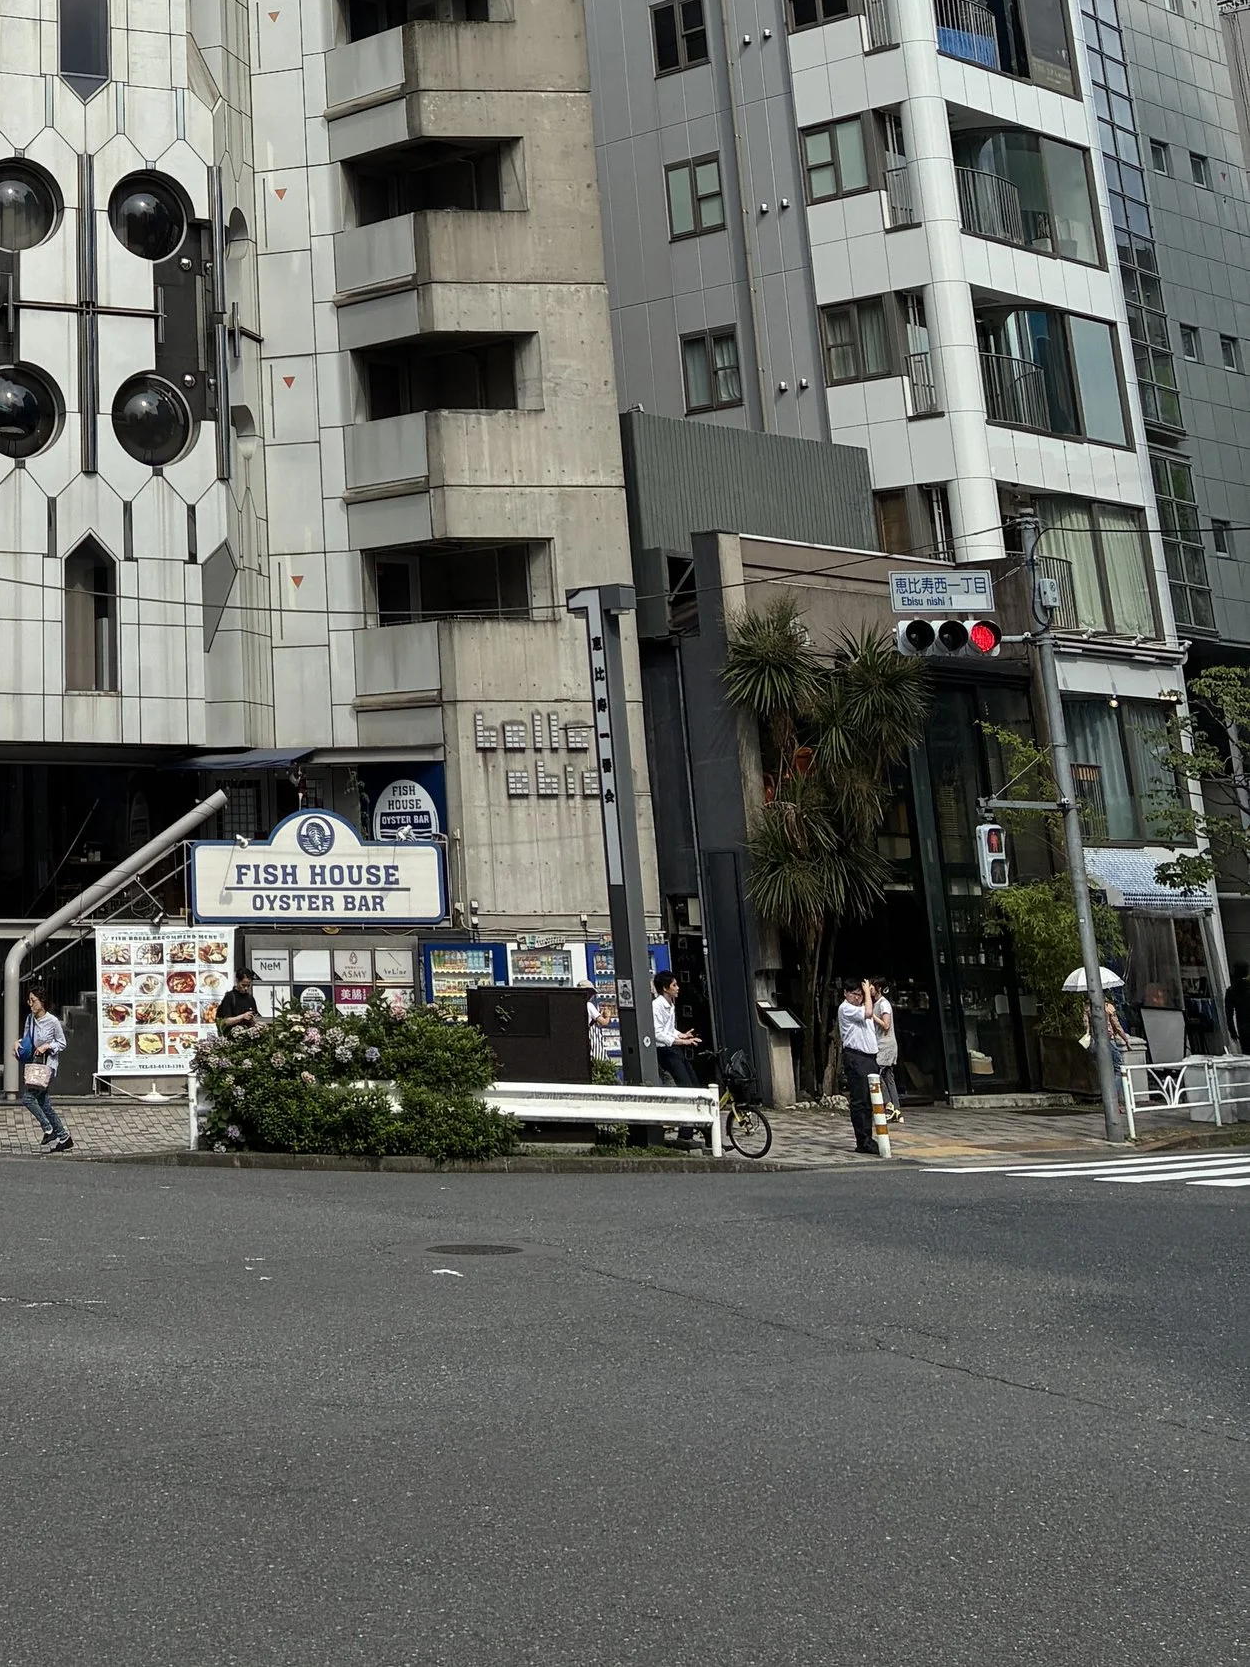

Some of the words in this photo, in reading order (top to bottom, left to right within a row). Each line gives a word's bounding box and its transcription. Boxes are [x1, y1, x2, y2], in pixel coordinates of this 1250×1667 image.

[894, 576, 987, 594] 恵比寿西一丁目
[901, 596, 924, 607] Ebisu
[926, 596, 946, 607] nishi
[475, 713, 589, 749] belle
[392, 785, 416, 797] FISH
[388, 798, 422, 811] HOUSE
[381, 815, 412, 825] OYSTER
[413, 814, 430, 824] BAR
[235, 863, 299, 886] FISH
[309, 864, 400, 887] HOUSE
[251, 893, 335, 912] OYSTER
[342, 894, 386, 912] BAR
[260, 961, 281, 971] NeM
